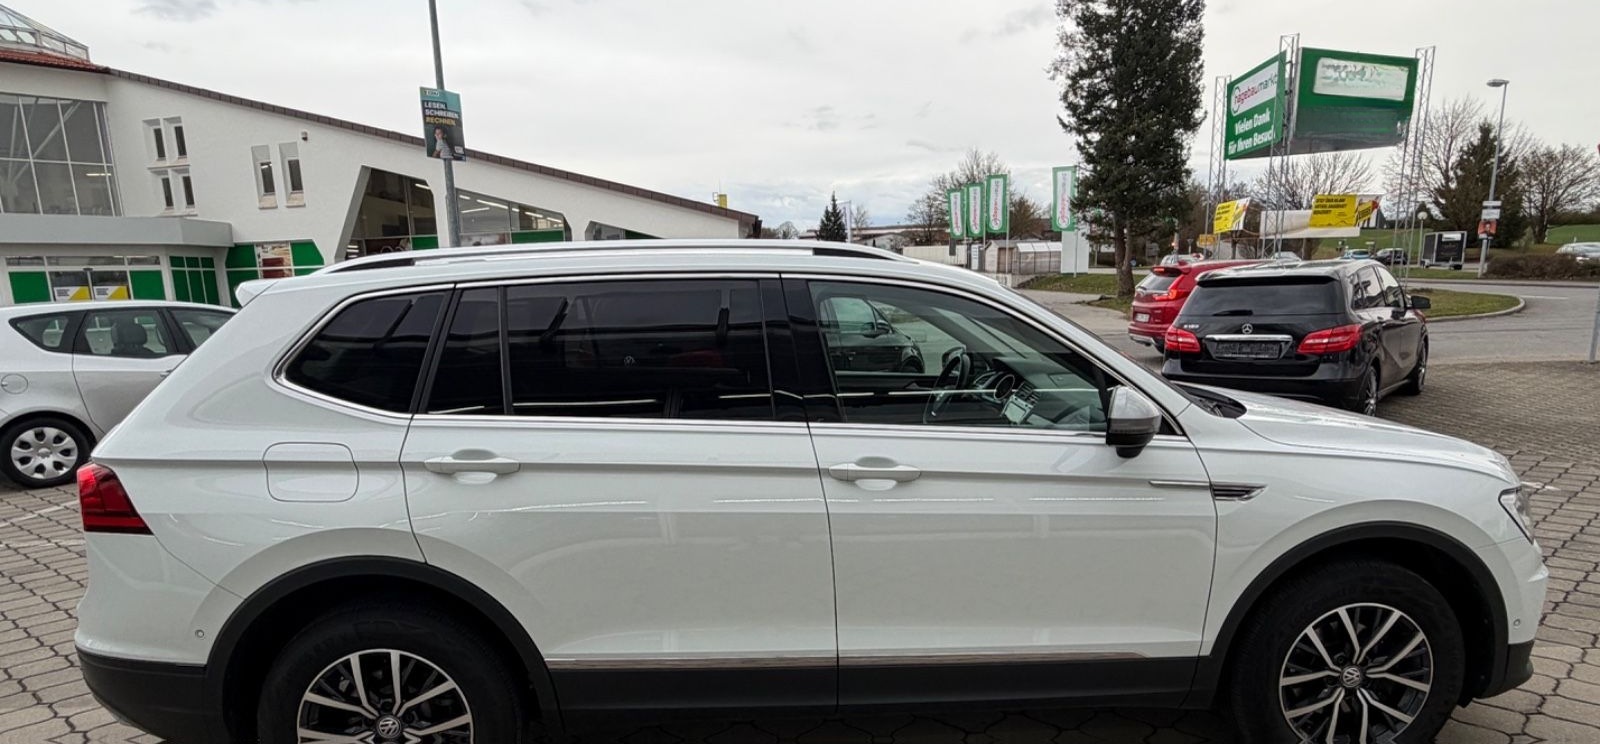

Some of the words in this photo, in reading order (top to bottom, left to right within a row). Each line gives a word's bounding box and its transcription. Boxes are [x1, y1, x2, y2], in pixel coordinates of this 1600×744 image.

[1235, 118, 1253, 135] Vielen
[1254, 107, 1271, 127] Dank
[1228, 141, 1237, 155] für
[1237, 137, 1252, 152] Ihren
